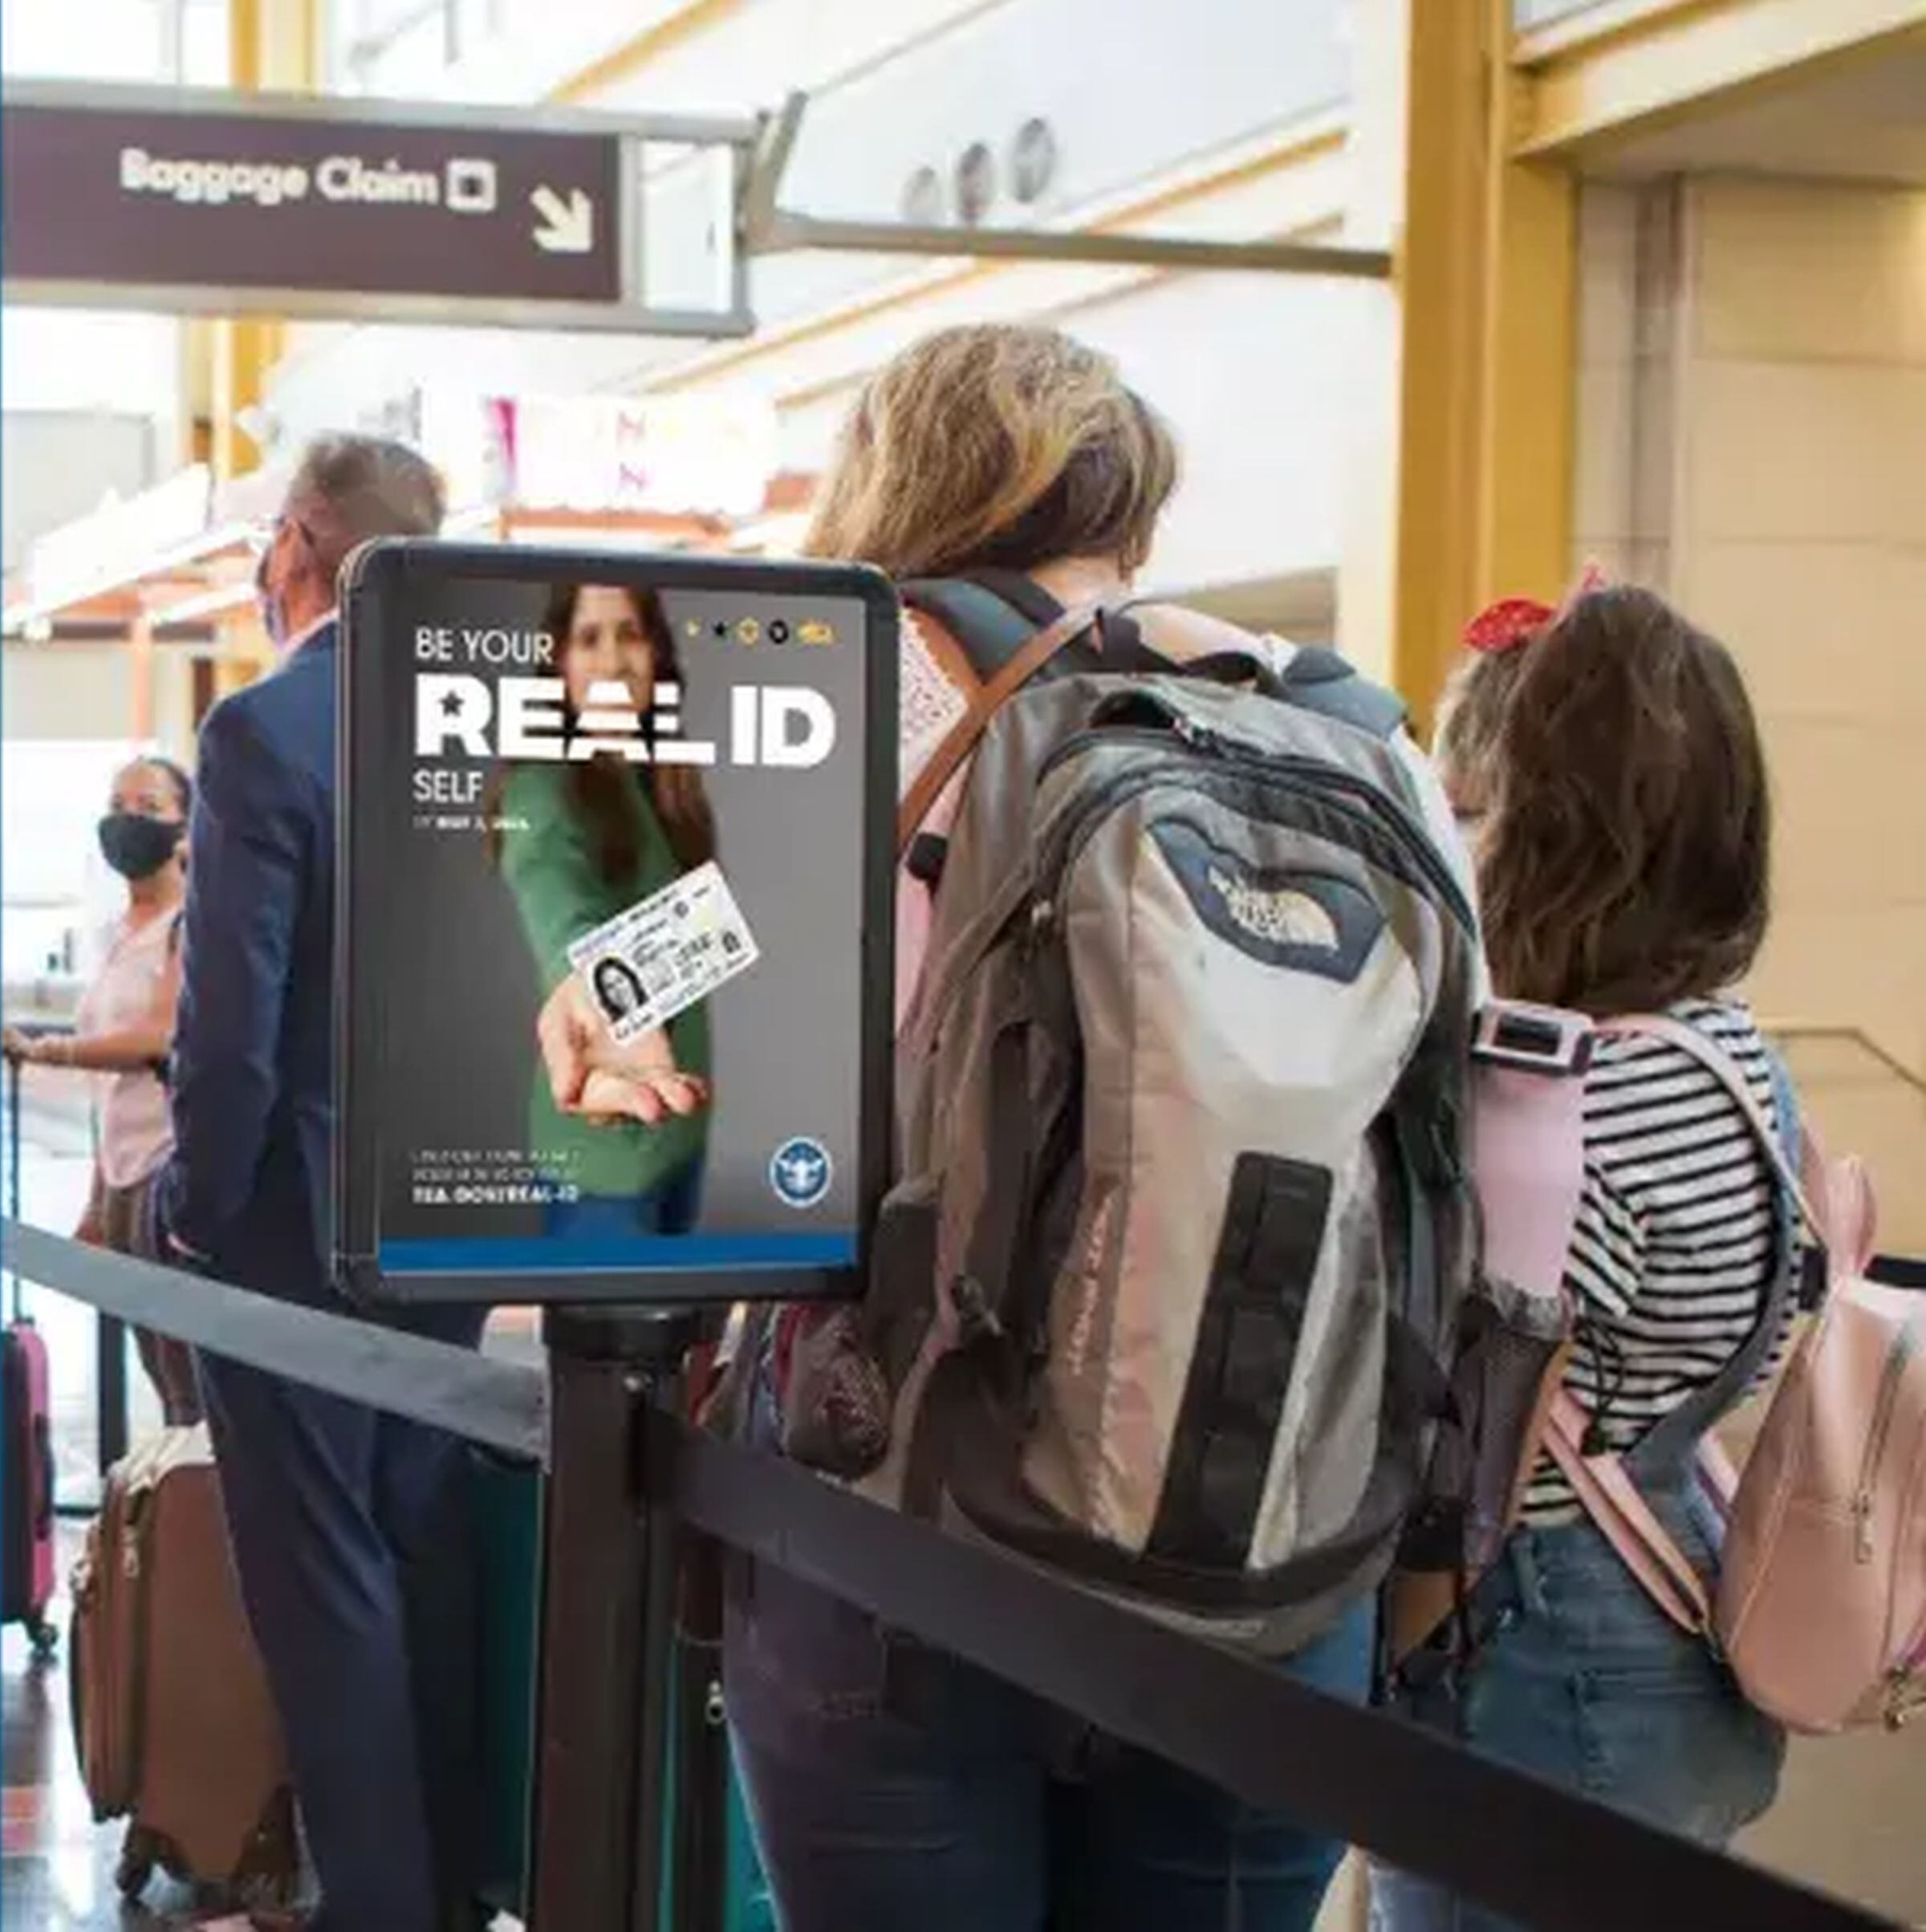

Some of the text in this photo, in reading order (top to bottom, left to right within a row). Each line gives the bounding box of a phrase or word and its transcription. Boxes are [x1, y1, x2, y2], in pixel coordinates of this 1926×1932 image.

[120, 147, 440, 205] Baggage Claim
[416, 627, 555, 665] BE YOUR
[415, 672, 836, 768] REAL ID
[412, 769, 482, 802] SELF
